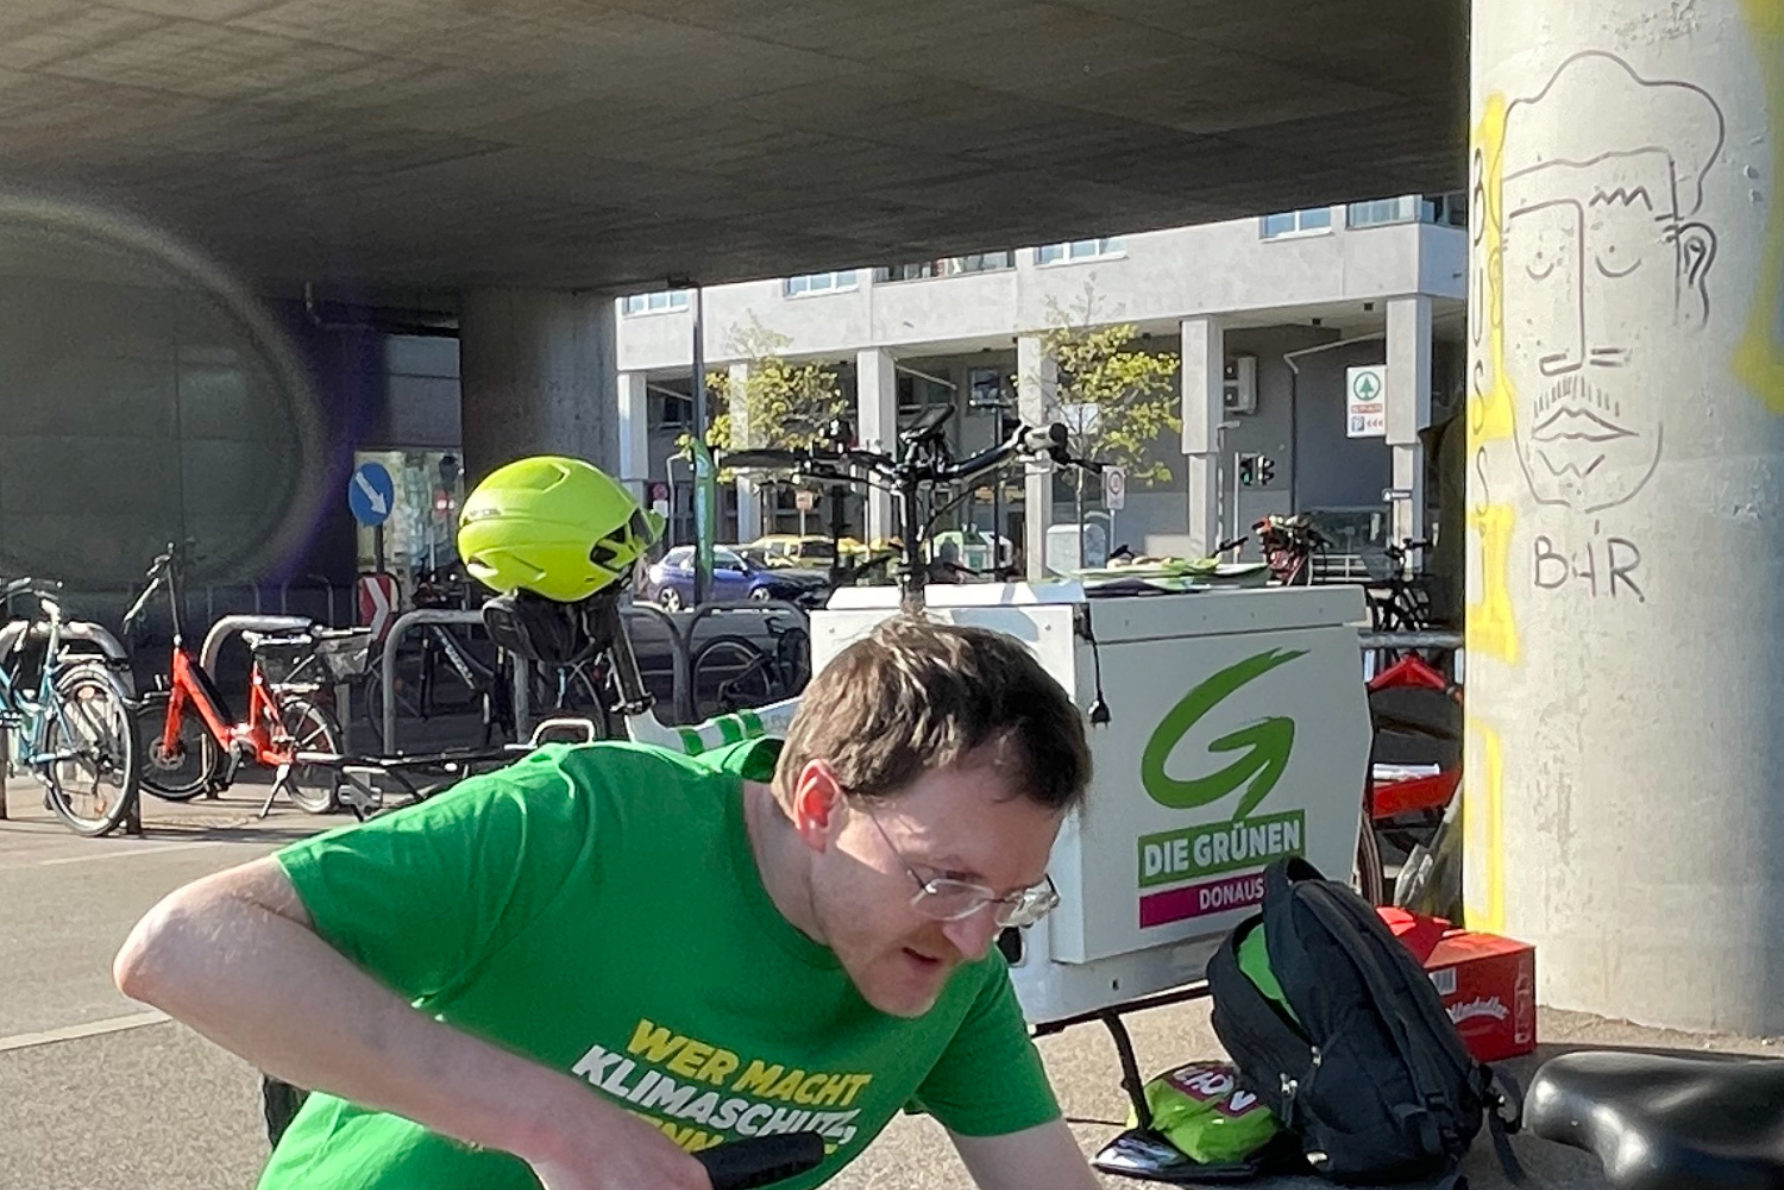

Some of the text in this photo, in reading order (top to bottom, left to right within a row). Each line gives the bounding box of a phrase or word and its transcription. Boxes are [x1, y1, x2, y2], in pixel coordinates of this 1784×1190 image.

[1144, 819, 1300, 877] DIE GRÜNEN
[627, 1018, 872, 1106] WER MACHT
